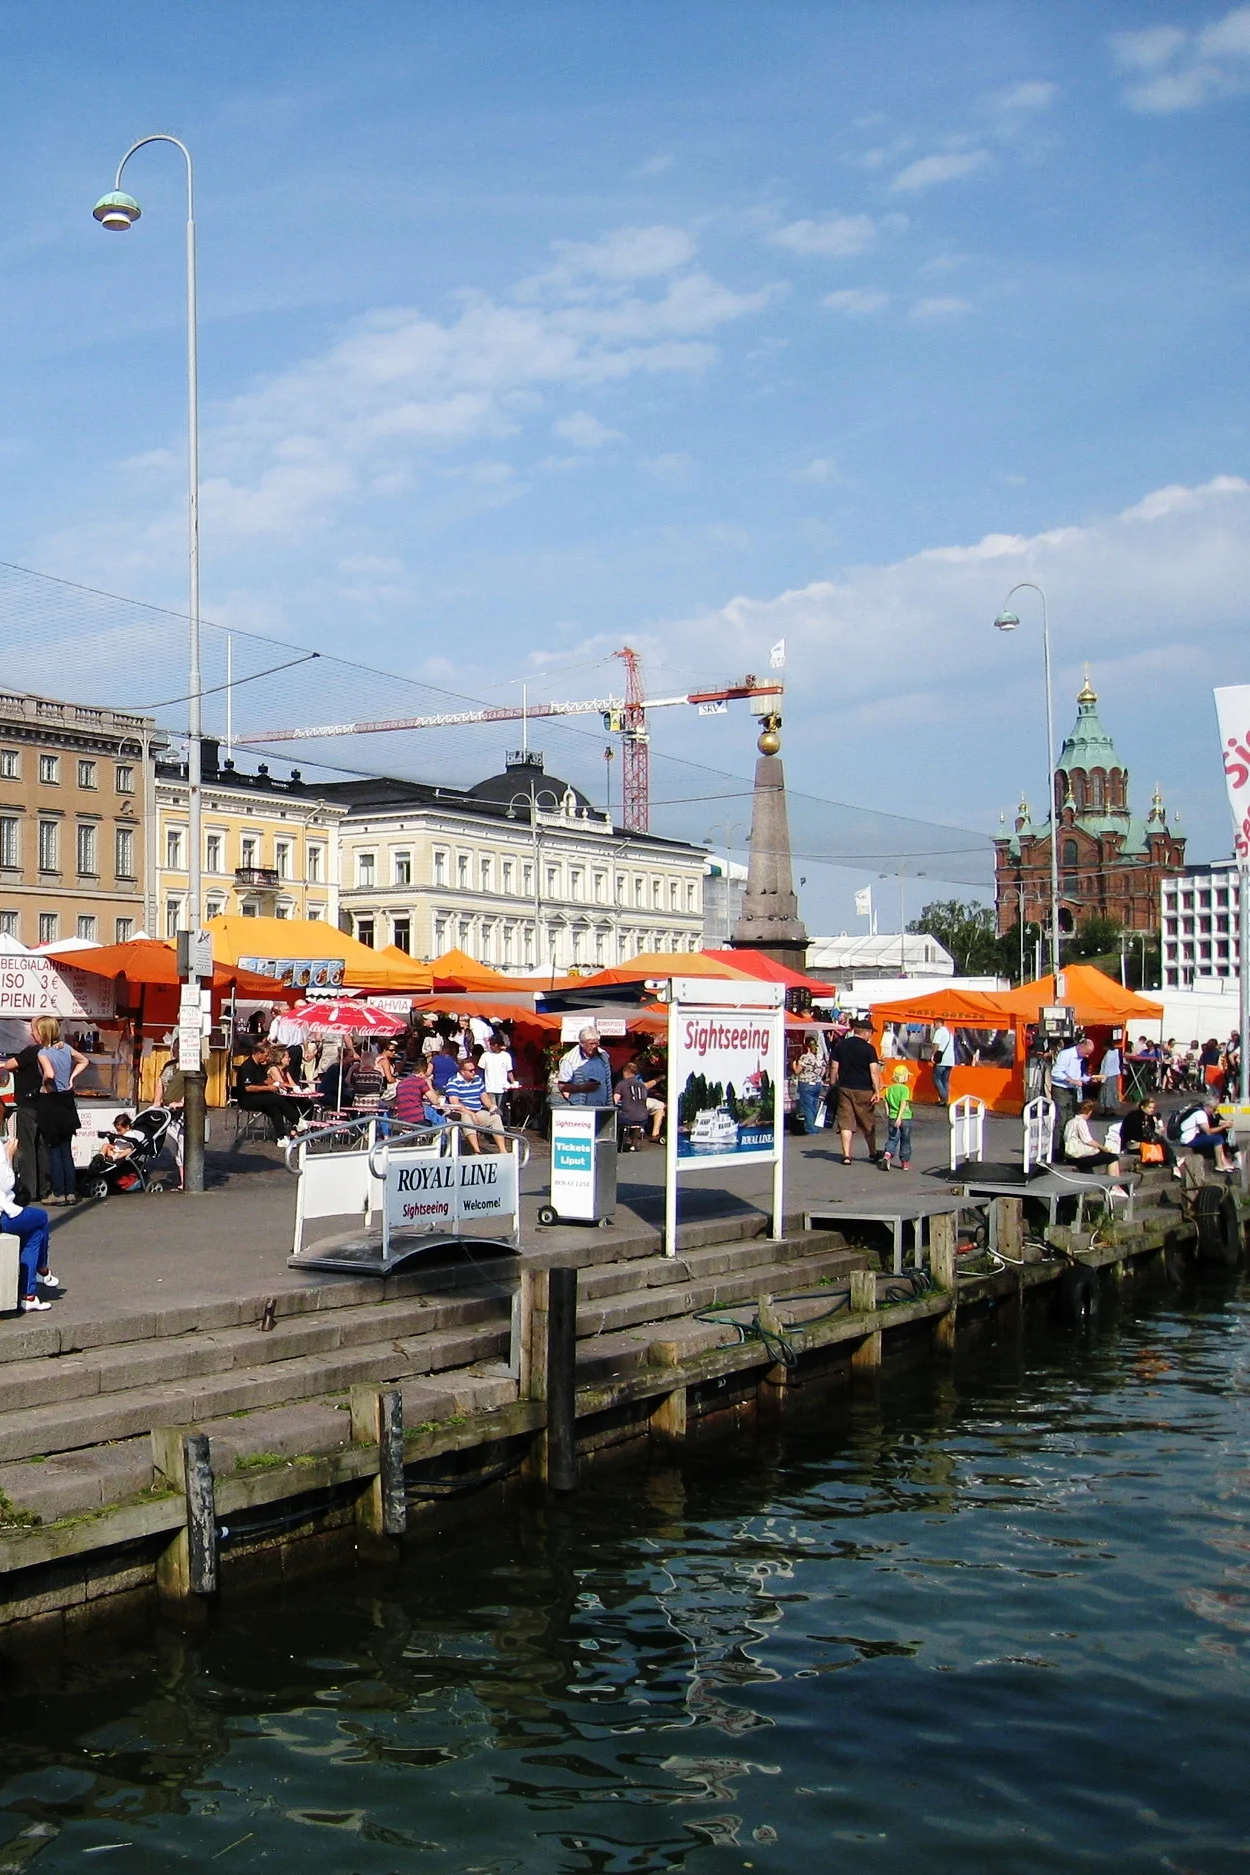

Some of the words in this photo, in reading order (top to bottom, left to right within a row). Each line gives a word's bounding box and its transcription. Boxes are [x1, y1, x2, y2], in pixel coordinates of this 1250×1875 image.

[702, 704, 719, 714] SRV
[1223, 731, 1250, 788] Si
[2, 974, 24, 989] ISO
[41, 975, 49, 990] 3
[52, 976, 59, 990] €
[0, 993, 36, 1008] PIENI
[40, 994, 47, 1008] 2
[51, 995, 58, 1009] €
[369, 998, 408, 1011] KAHVIA
[684, 1020, 770, 1056] Sightseeing
[554, 1120, 591, 1129] Sightseeing
[555, 1142, 591, 1153] Tickets
[560, 1155, 586, 1166] Liput
[397, 1166, 455, 1192] ROYAL
[460, 1163, 498, 1187] LINE
[402, 1201, 449, 1220] Sightseeing
[463, 1197, 501, 1211] Welcome!
